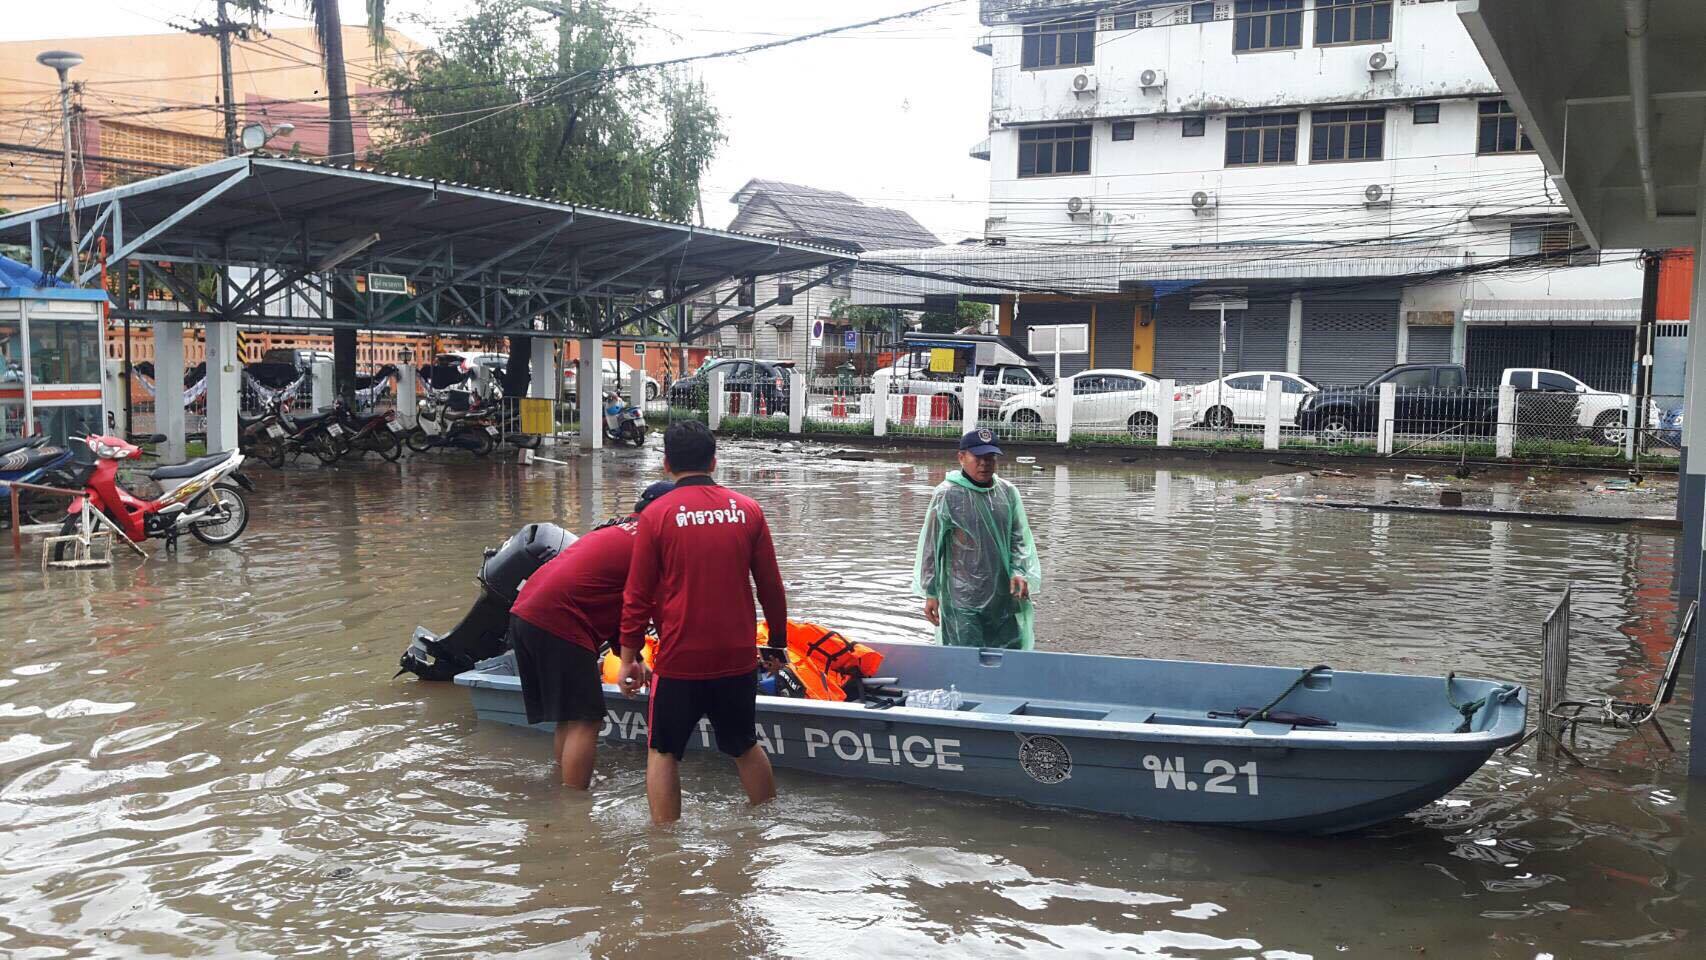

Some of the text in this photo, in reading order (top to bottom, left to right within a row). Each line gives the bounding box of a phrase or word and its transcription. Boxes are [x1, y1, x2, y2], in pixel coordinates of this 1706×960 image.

[675, 498, 746, 527] ตำรวจน้ำ
[697, 717, 785, 755] TAI
[804, 727, 964, 771] POLICE
